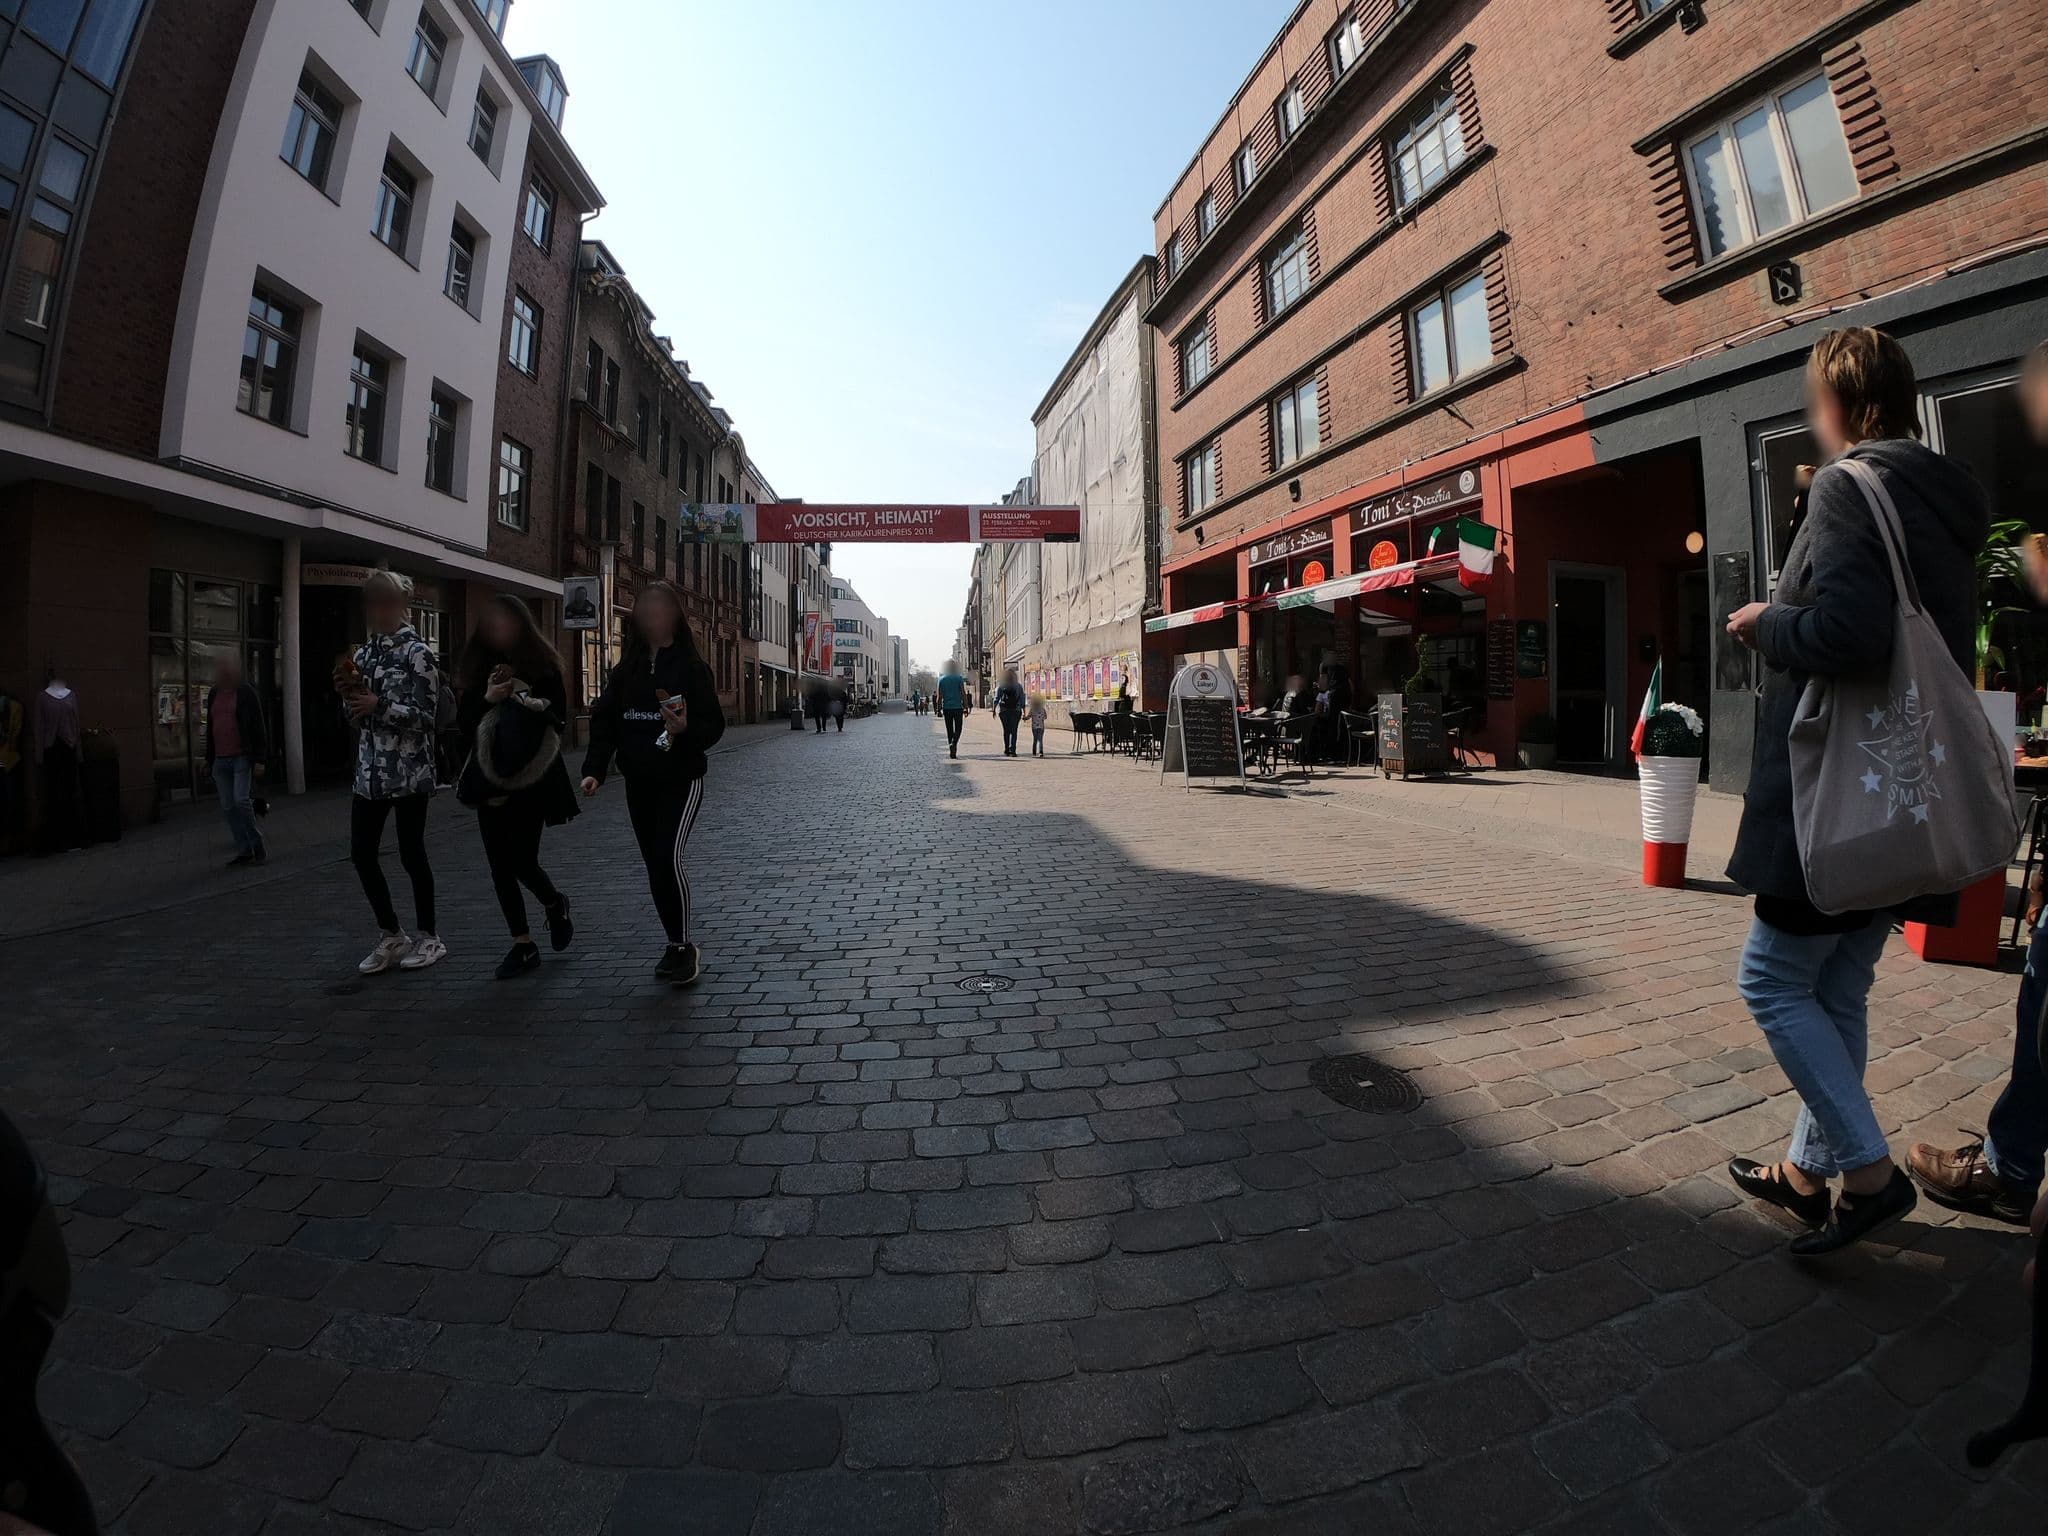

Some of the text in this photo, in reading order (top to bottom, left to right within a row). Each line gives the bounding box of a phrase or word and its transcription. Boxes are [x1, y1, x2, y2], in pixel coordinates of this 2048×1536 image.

[982, 512, 1031, 520] AUSSTELLUNG
[793, 526, 934, 540] DEUTSCHER KARIKATURENPREIS 2018
[623, 708, 661, 720] ellesse
[1895, 744, 1919, 761] START
